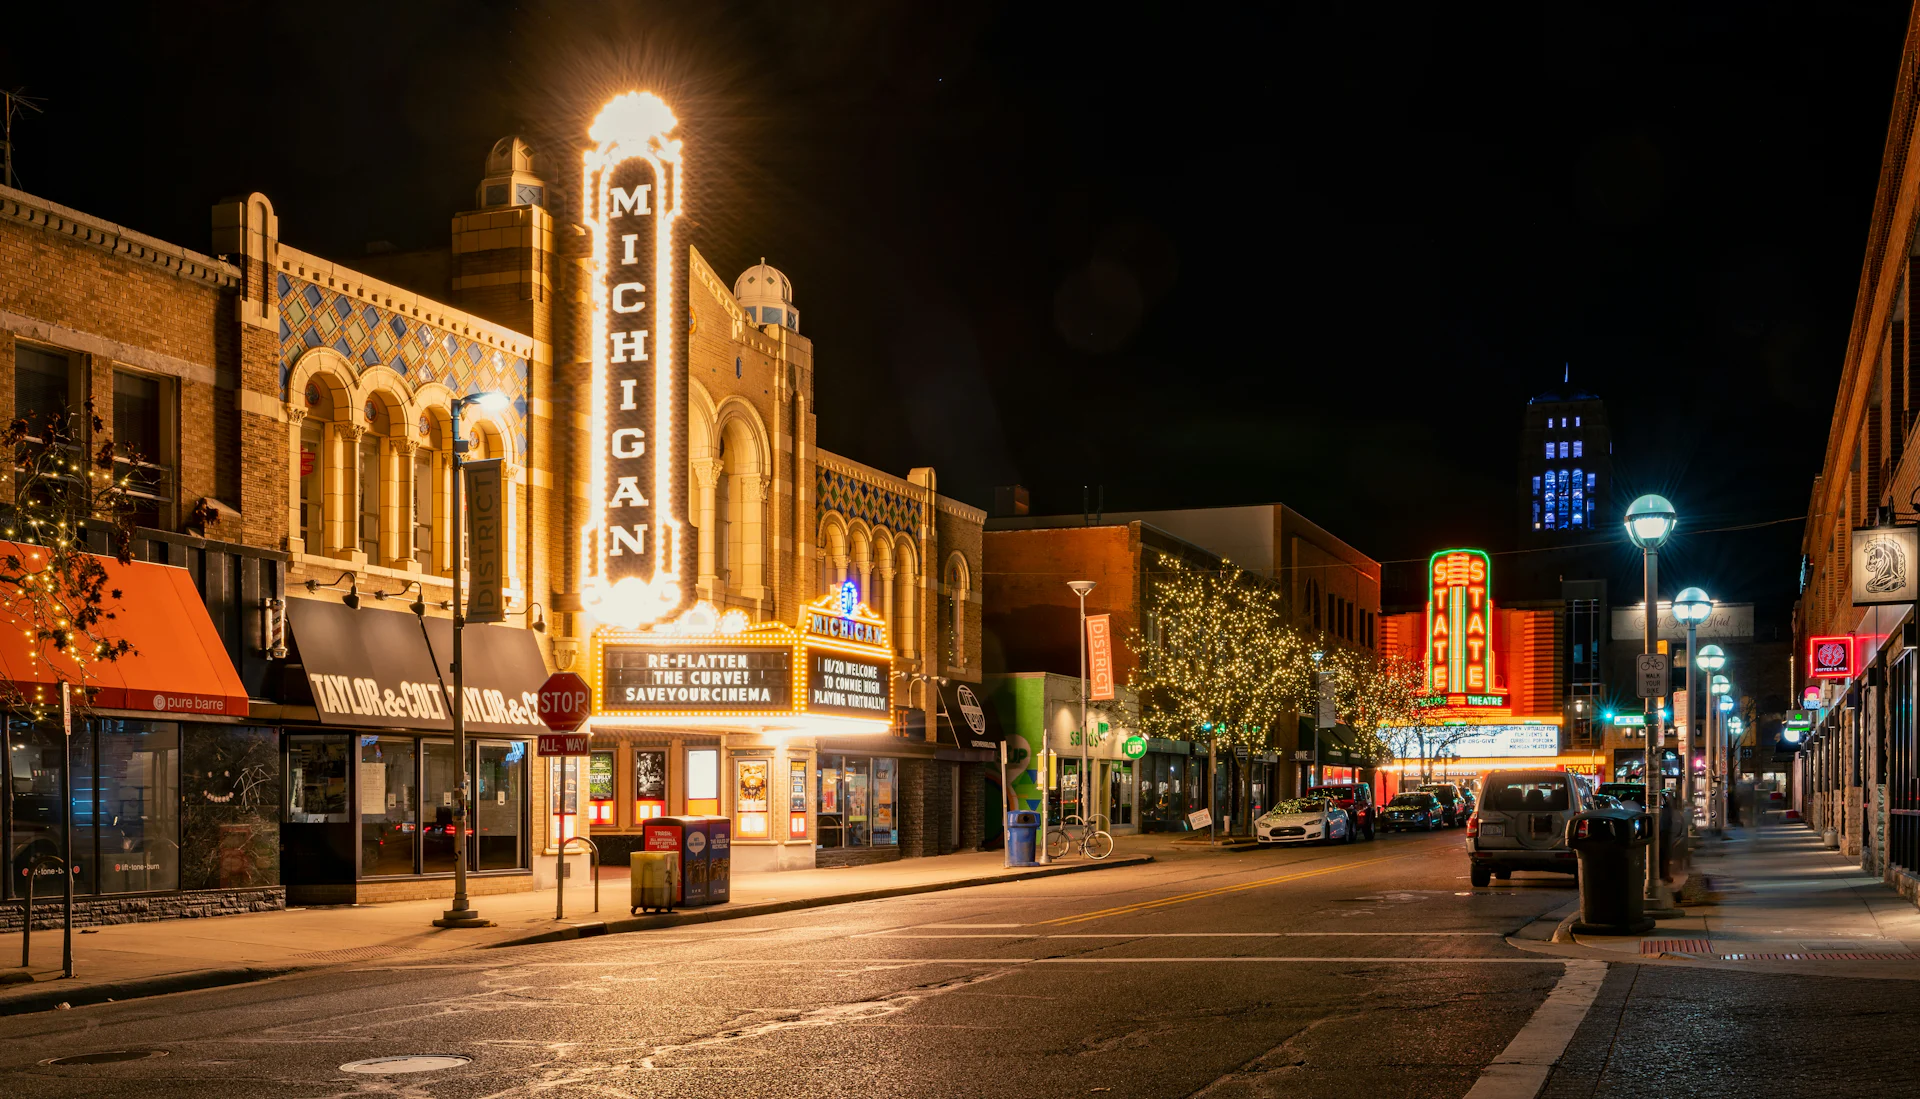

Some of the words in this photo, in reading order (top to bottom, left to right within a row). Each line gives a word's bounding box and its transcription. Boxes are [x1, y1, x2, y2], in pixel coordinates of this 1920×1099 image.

[609, 183, 652, 557] MICHIGAN
[474, 475, 494, 608] DISTRICT
[812, 614, 883, 645] MICHIGAN
[1434, 562, 1448, 688] STATE
[1467, 560, 1485, 688] STATE
[648, 654, 749, 668] RE-FLATTEN
[1092, 623, 1109, 692] DISTRICT
[653, 671, 683, 685] THE
[690, 671, 749, 685] CURVE!
[845, 661, 878, 680] WELCOME
[625, 687, 771, 702] SAVEYOURCINEMA
[823, 675, 834, 689] TO
[863, 680, 880, 695] HIGH
[167, 697, 193, 711] pure
[194, 697, 224, 711] barre
[540, 691, 586, 713] STOP
[814, 689, 846, 706] PLAYING
[847, 694, 885, 711] VIRTUALLY
[1467, 695, 1503, 706] THEATRE
[1127, 744, 1143, 755] UP
[1566, 765, 1597, 775] STATE
